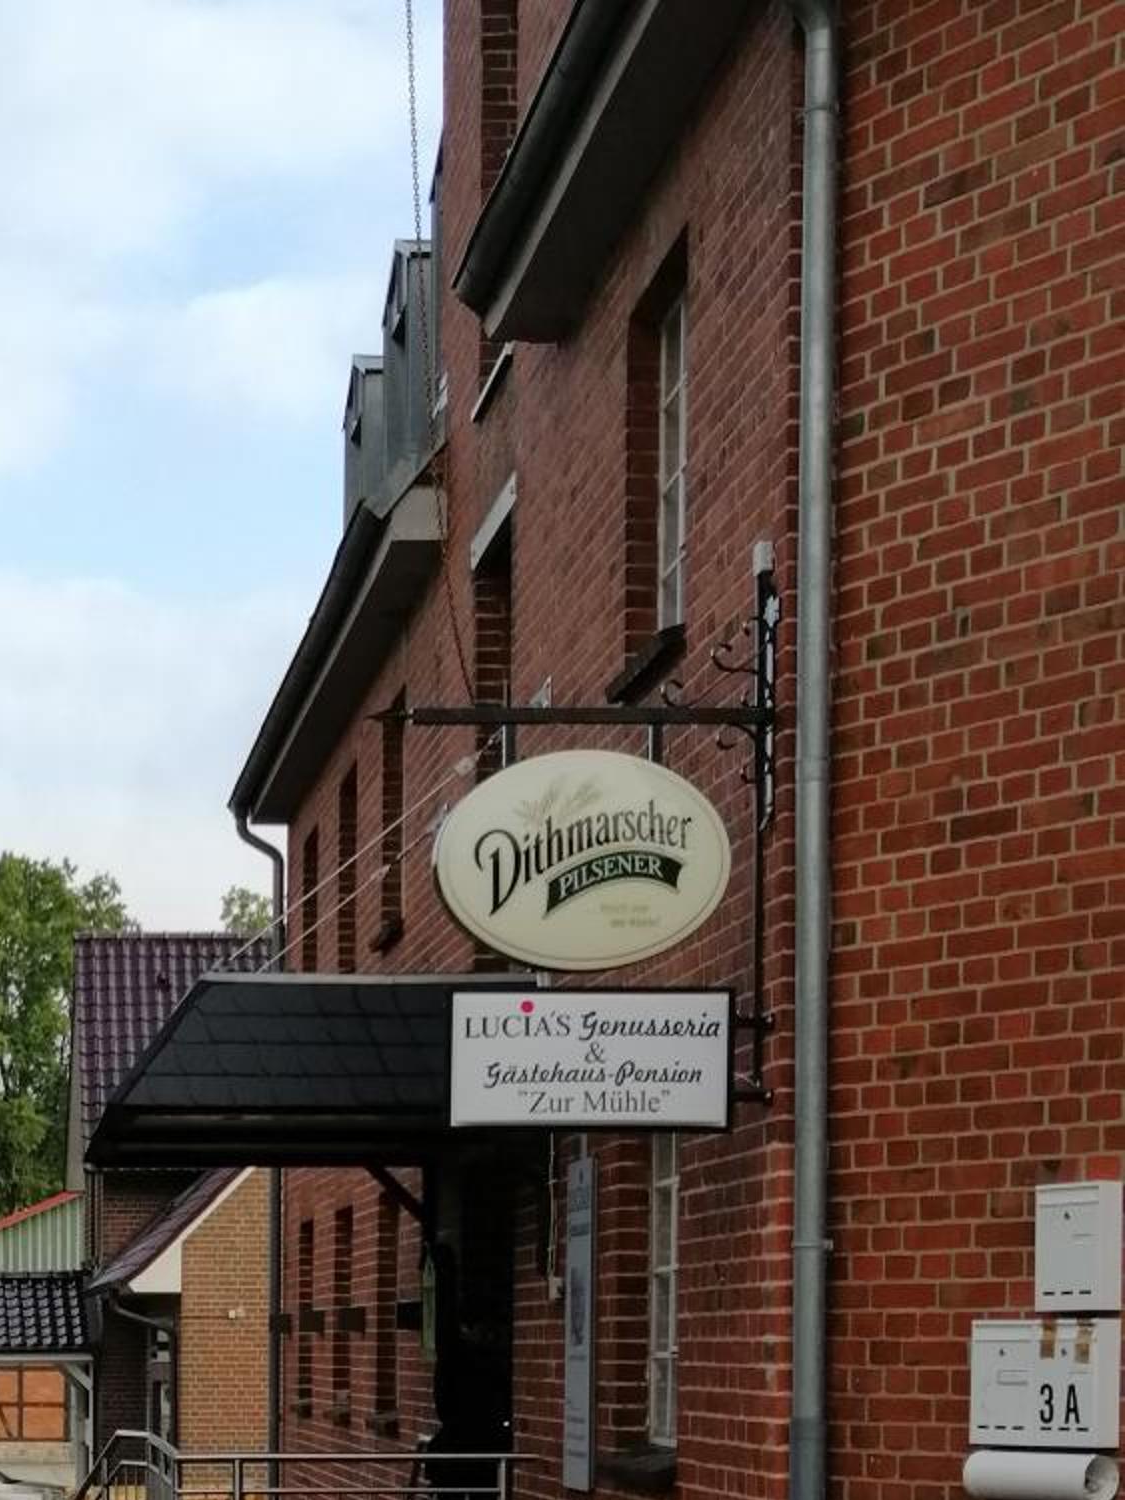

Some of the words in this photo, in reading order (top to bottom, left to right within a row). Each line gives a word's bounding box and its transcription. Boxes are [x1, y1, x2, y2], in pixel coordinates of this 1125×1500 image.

[475, 800, 692, 917] Dithmarscher
[558, 855, 665, 899] PILSENER
[578, 1012, 721, 1040] Genusseria
[584, 1042, 605, 1063] &
